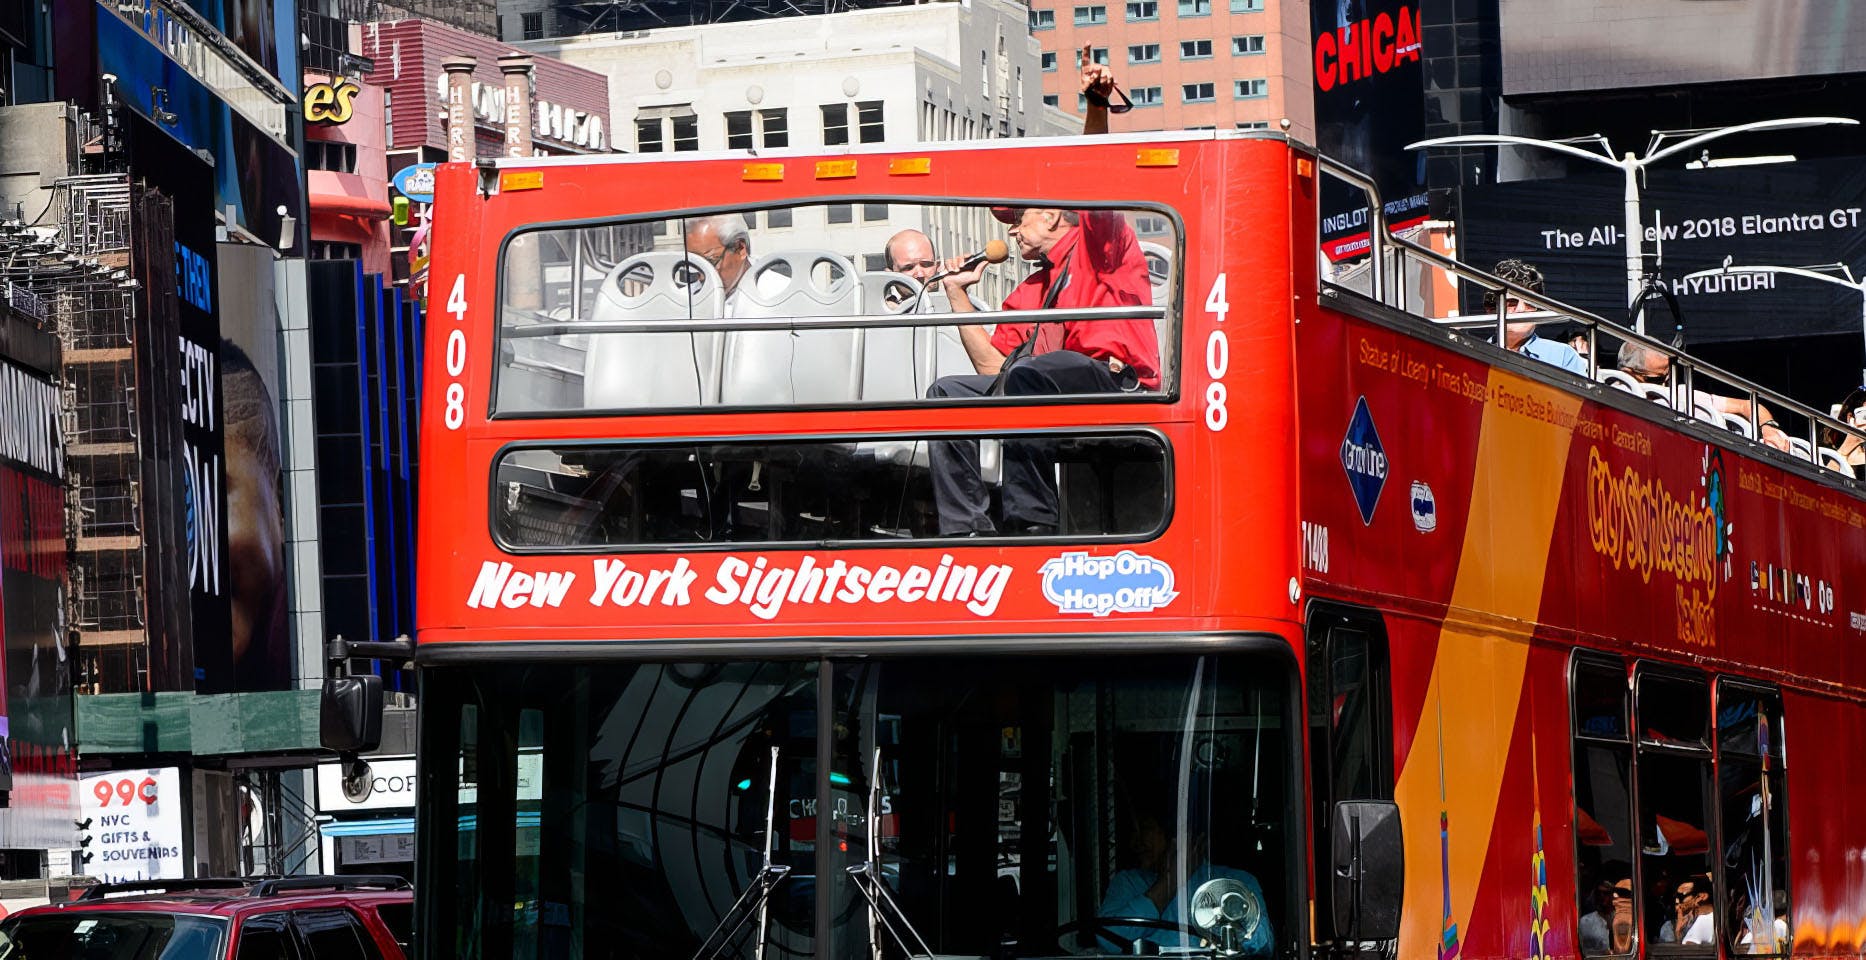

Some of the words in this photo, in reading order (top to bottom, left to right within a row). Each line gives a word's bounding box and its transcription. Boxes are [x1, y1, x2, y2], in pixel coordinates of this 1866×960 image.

[1315, 6, 1421, 92] CHICA
[1323, 206, 1369, 234] INGLOT
[1541, 229, 1583, 249] The
[1683, 219, 1736, 239] 2018
[1742, 212, 1824, 236] Elantra
[1829, 208, 1861, 228] GT
[1673, 272, 1775, 296] HYUNDAI
[445, 274, 467, 430] 408
[1205, 273, 1229, 431] 408
[1064, 555, 1115, 580] Hop
[1116, 553, 1152, 575] On
[466, 561, 575, 608] New
[589, 557, 698, 607] York
[704, 553, 1012, 620] Sightseeing
[1063, 588, 1114, 613] Hop
[1115, 587, 1153, 608] Off
[101, 831, 138, 843] GIFTS
[142, 830, 151, 842] &
